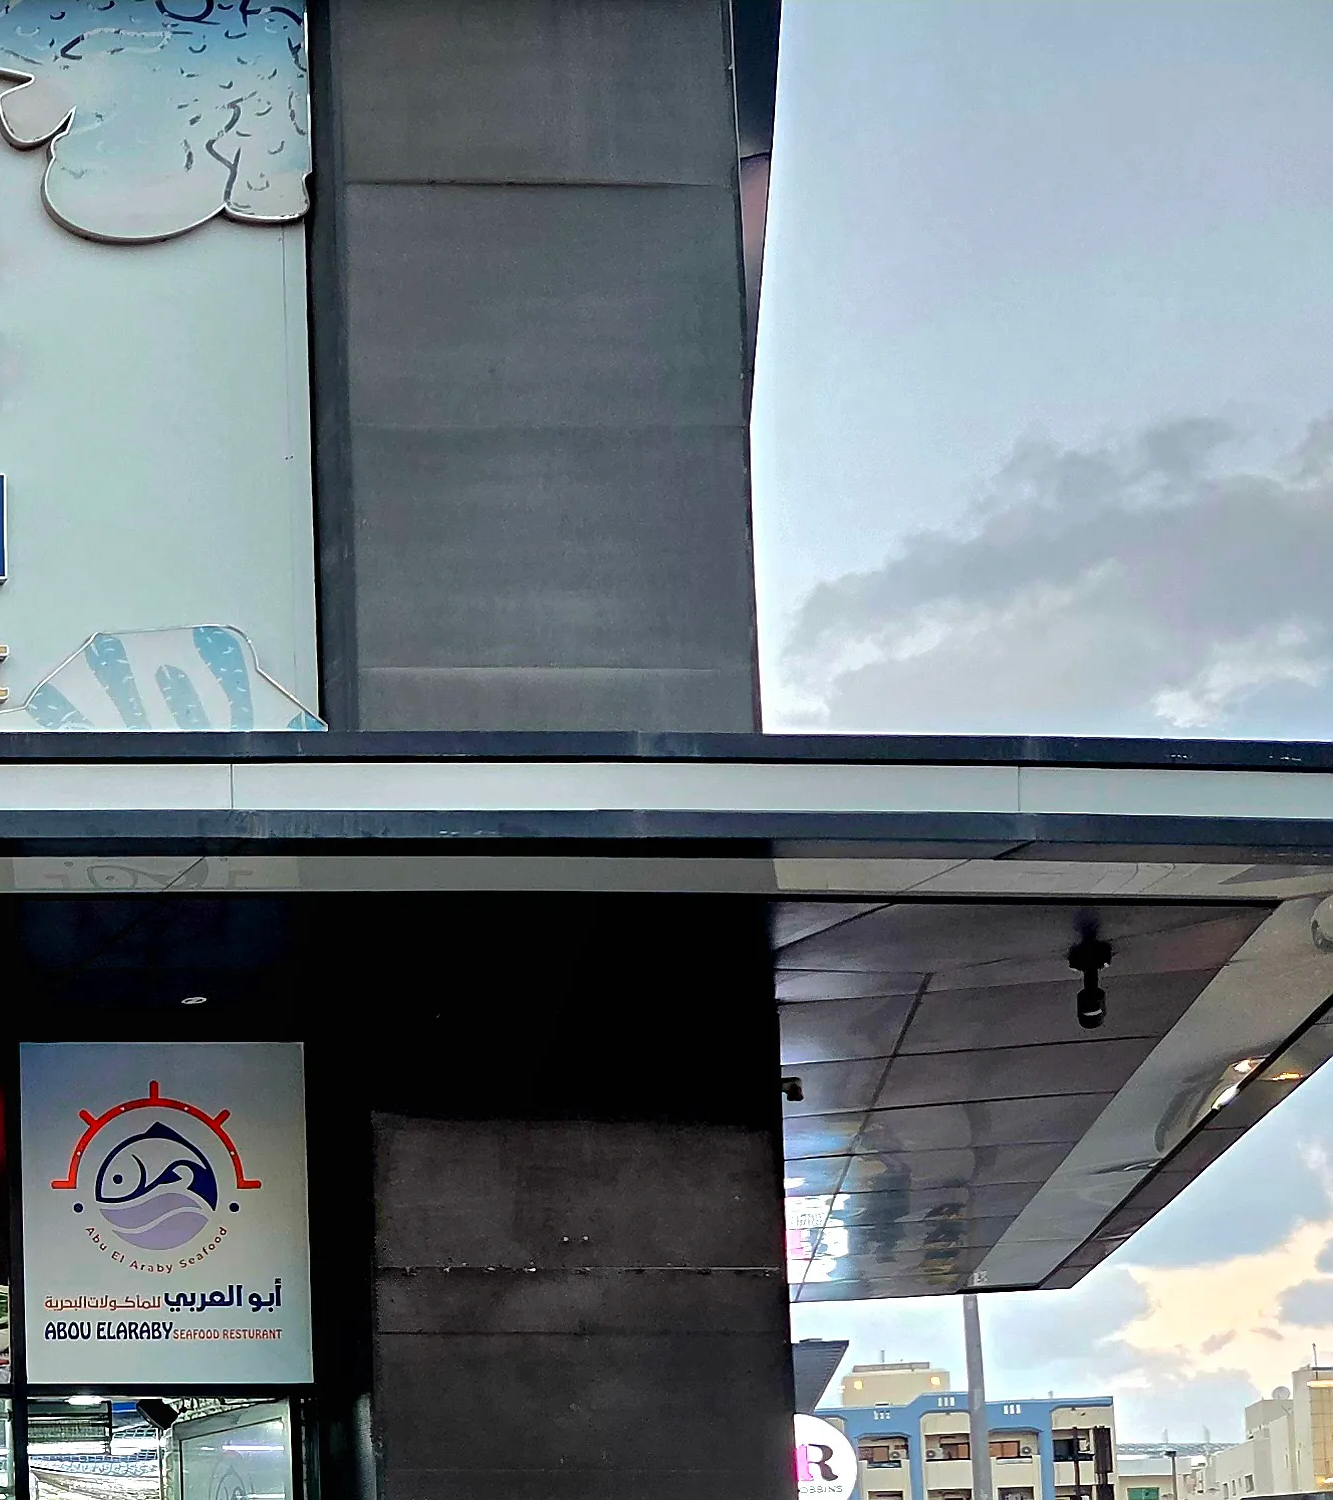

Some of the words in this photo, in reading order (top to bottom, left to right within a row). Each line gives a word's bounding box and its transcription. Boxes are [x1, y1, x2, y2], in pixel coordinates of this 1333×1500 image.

[86, 1226, 107, 1251] Abu
[111, 1251, 125, 1263] El
[129, 1259, 173, 1274] Araby
[179, 1227, 228, 1268] Seafood
[164, 1284, 243, 1313] العربي
[248, 1278, 282, 1313] أبو
[45, 1321, 91, 1340] ABOU
[97, 1321, 173, 1340] ELARABY
[173, 1329, 220, 1340] SEAFOOD
[223, 1328, 283, 1340] RESTURANT
